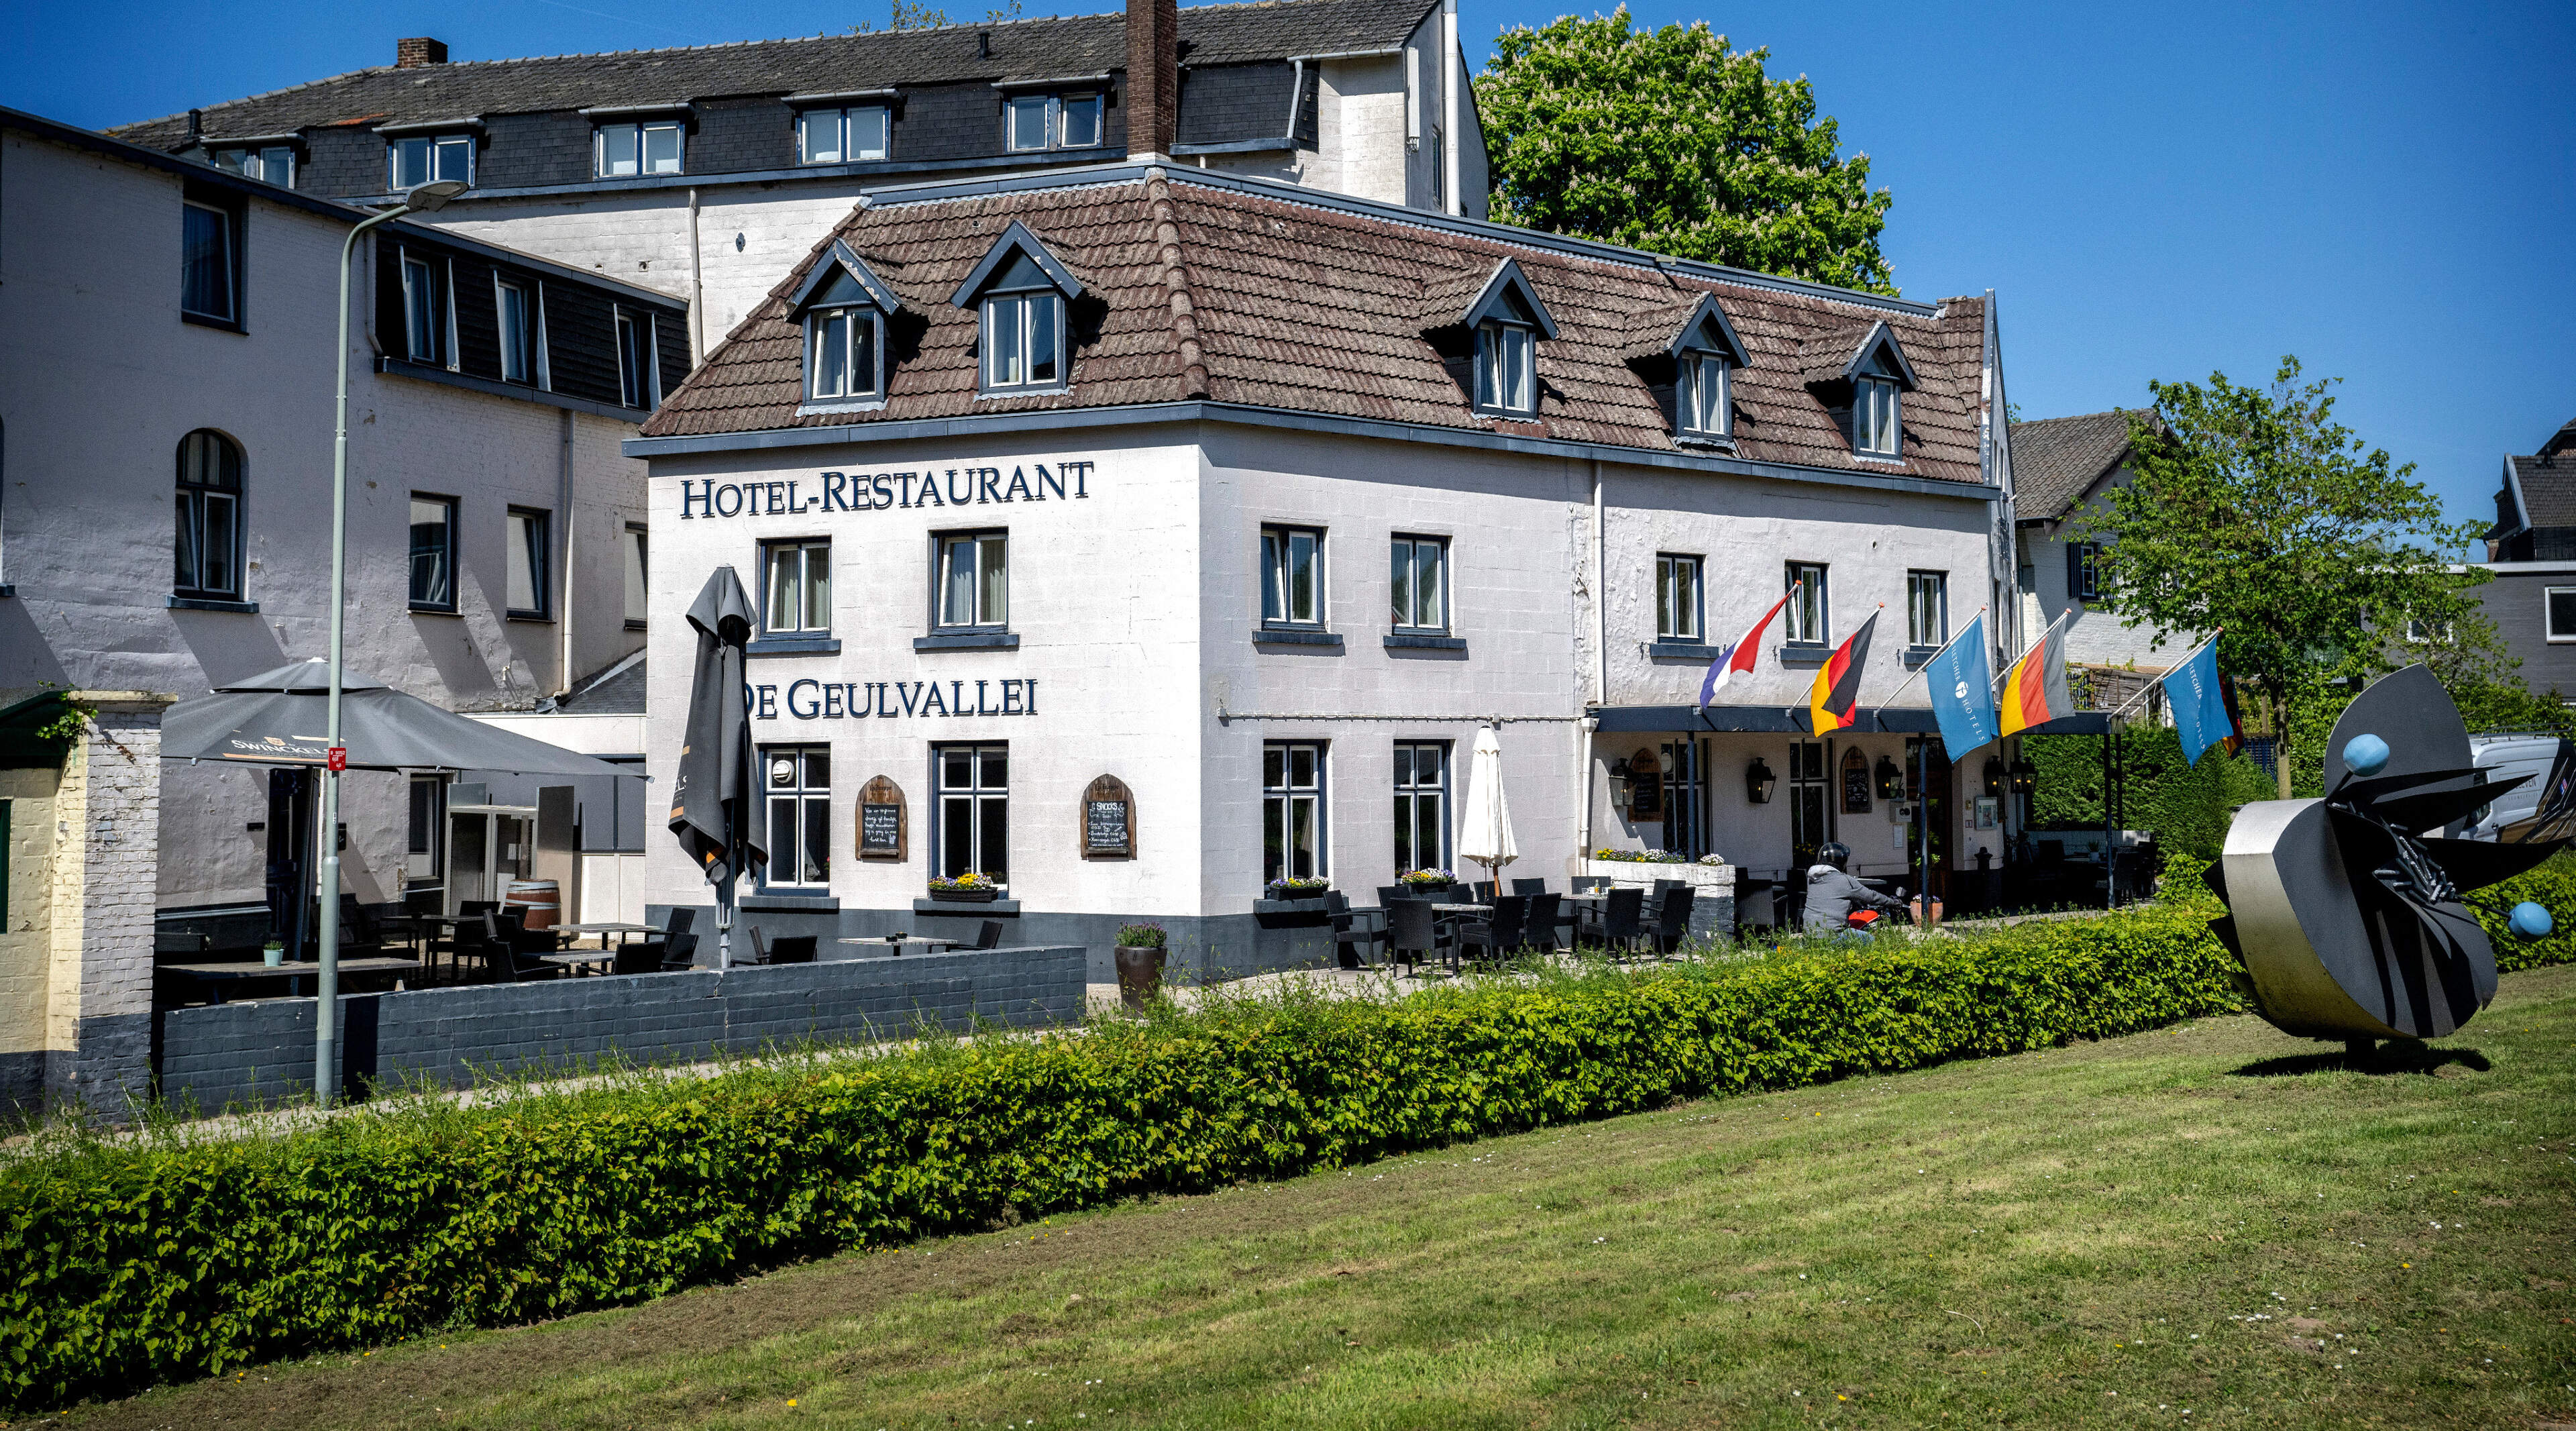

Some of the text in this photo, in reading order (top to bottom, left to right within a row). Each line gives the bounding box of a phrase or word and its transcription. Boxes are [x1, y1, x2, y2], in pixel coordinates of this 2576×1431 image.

[680, 462, 1094, 519] HOTEL-RESTAURANT
[746, 678, 1038, 720] E GEULVALLEI
[1962, 699, 1986, 741] HOTELS
